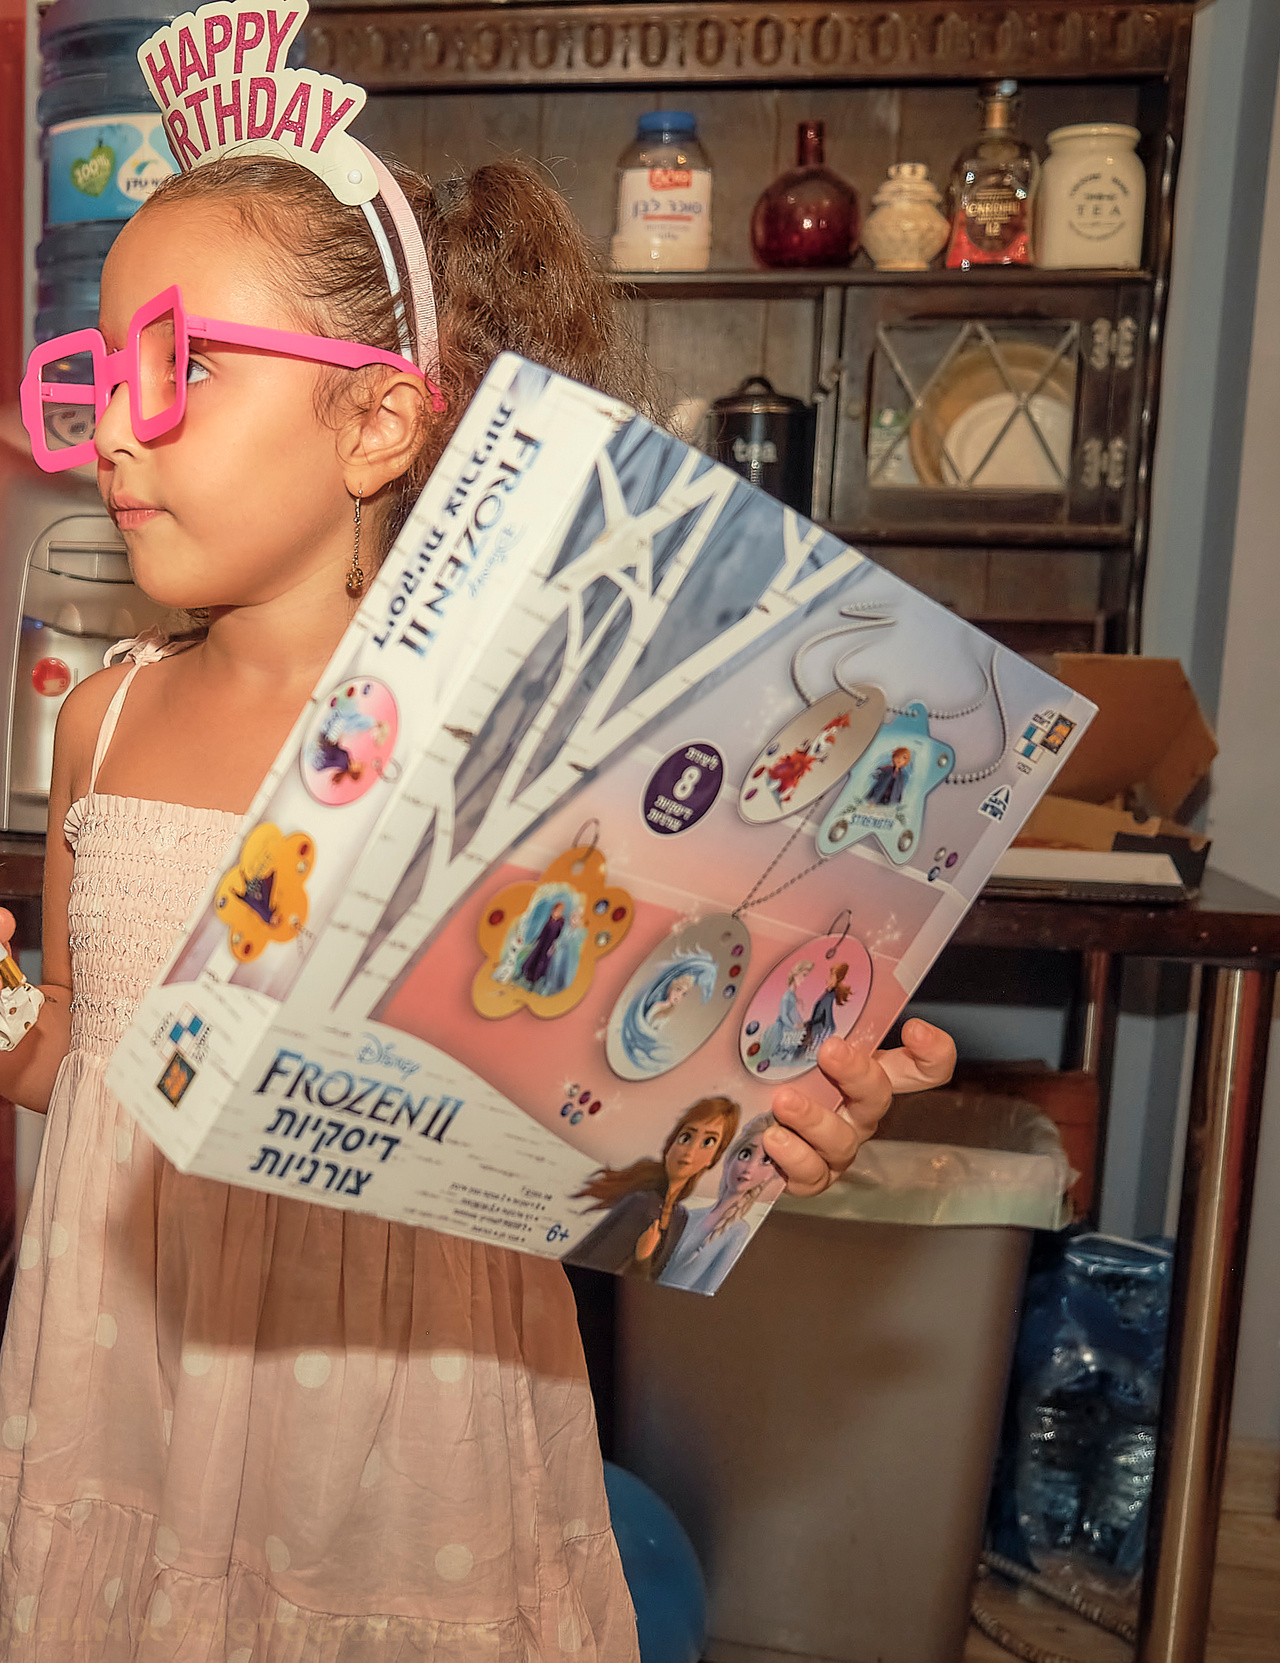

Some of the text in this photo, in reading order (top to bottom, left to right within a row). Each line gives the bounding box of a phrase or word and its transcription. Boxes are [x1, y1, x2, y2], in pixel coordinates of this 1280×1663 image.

[145, 10, 299, 108] HAPPY
[166, 76, 356, 168] RTHDAY
[1076, 204, 1121, 216] TEA
[373, 402, 516, 650] דיסקיות צורניות
[424, 428, 543, 617] FROZEN
[672, 765, 702, 801] 8
[848, 813, 895, 830] STRENGTH
[252, 1048, 465, 1144] FROZEN II
[265, 1107, 402, 1162] דיסקיות
[249, 1147, 372, 1196] צורניות
[545, 1224, 569, 1242] 6+
